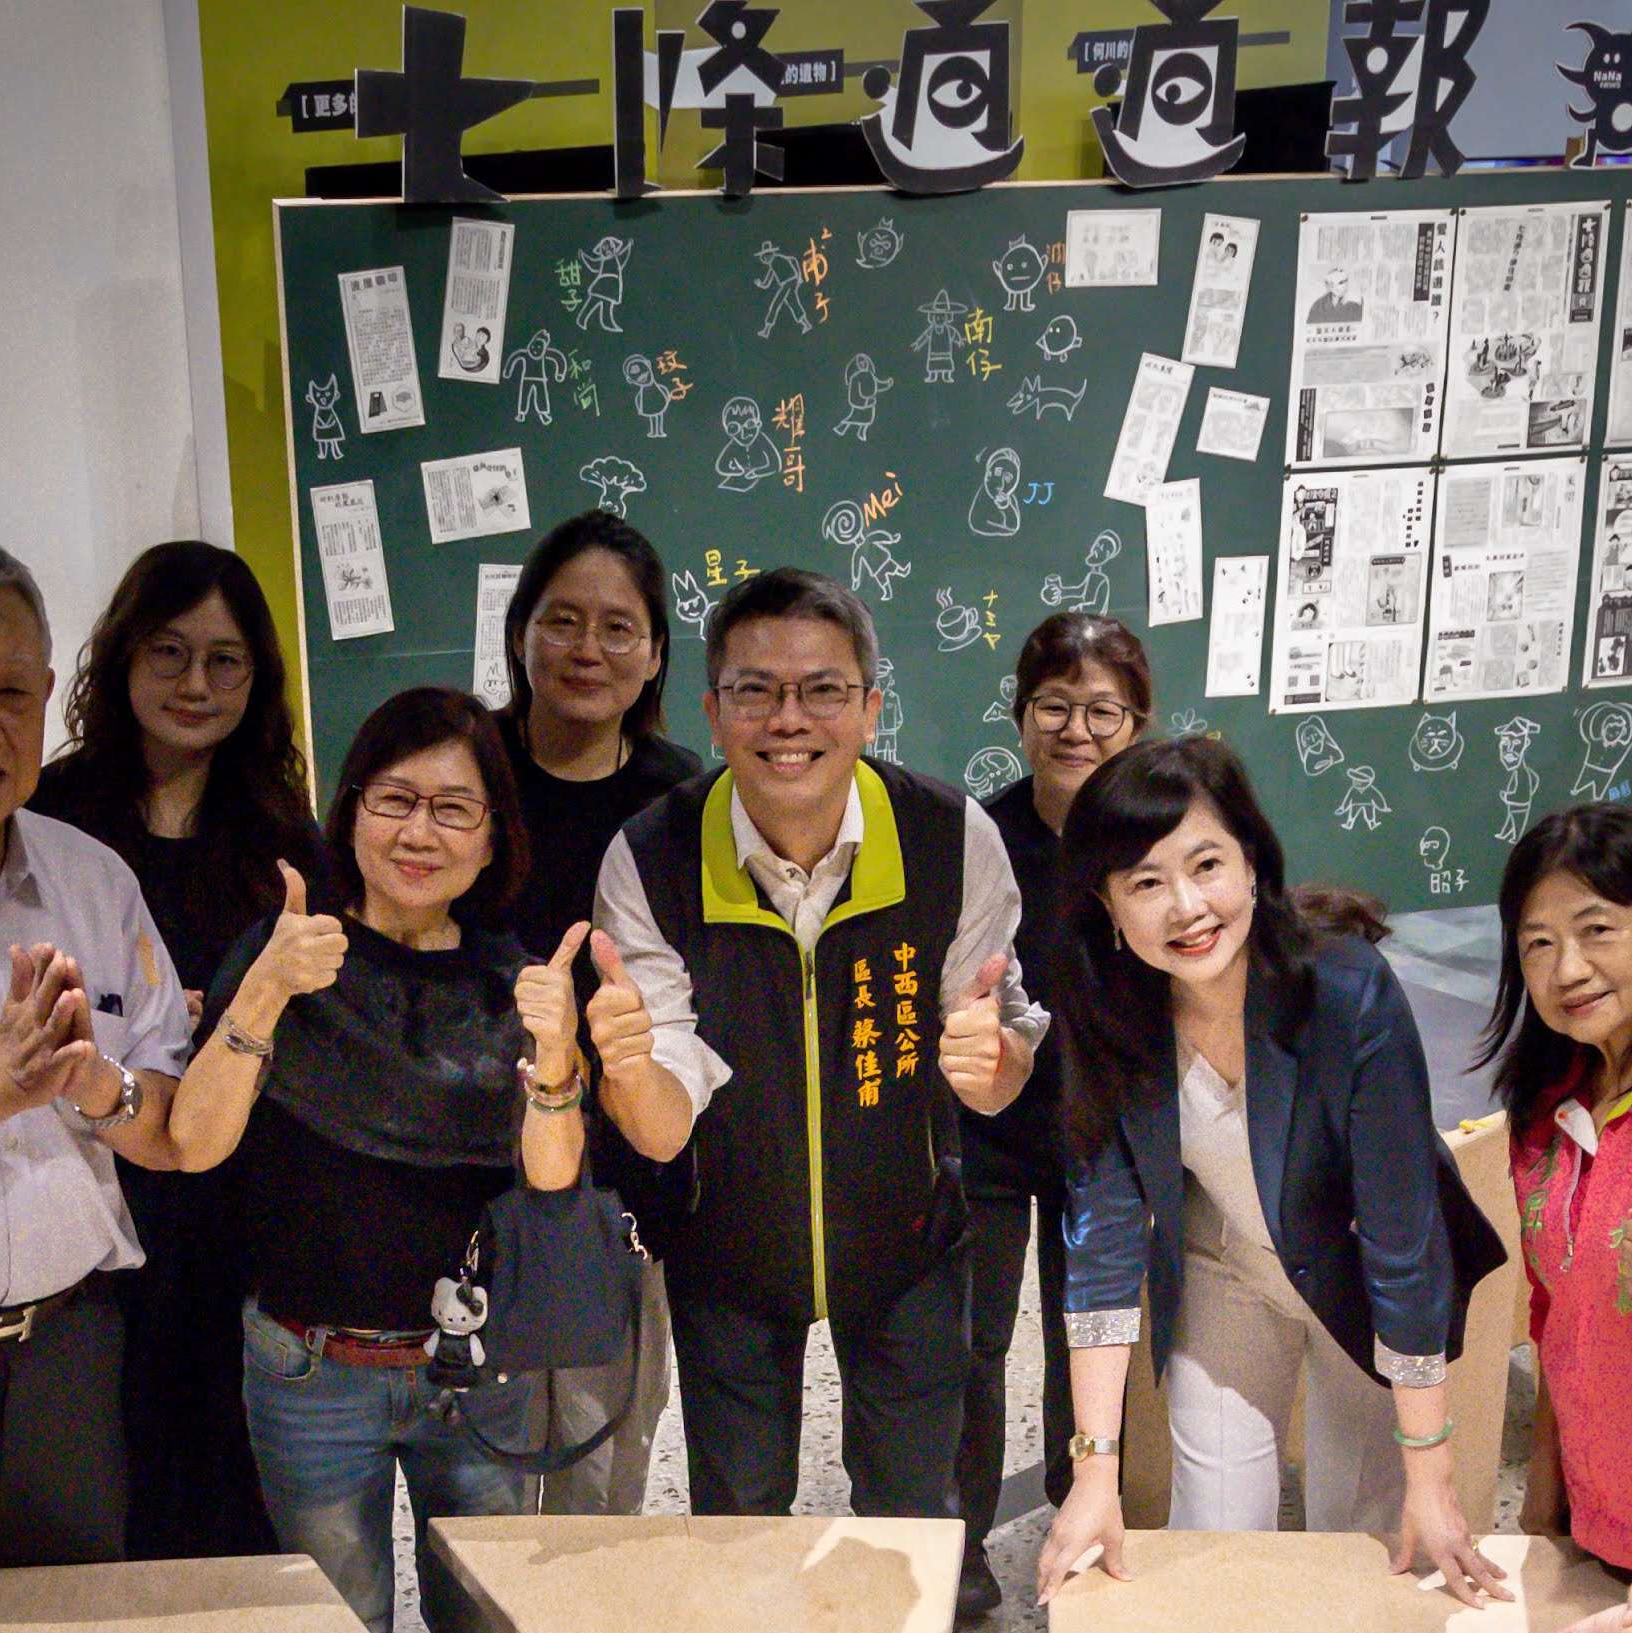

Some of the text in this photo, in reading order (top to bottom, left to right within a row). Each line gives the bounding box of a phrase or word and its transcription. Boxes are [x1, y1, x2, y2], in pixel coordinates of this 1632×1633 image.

[1593, 71, 1623, 82] NaNa
[964, 307, 1003, 382] 南仔
[863, 471, 904, 527] Mei
[1022, 482, 1055, 506] JJ
[1430, 868, 1470, 894] 昭子
[853, 958, 877, 1010] 區長
[893, 941, 921, 1079] 中西區公所
